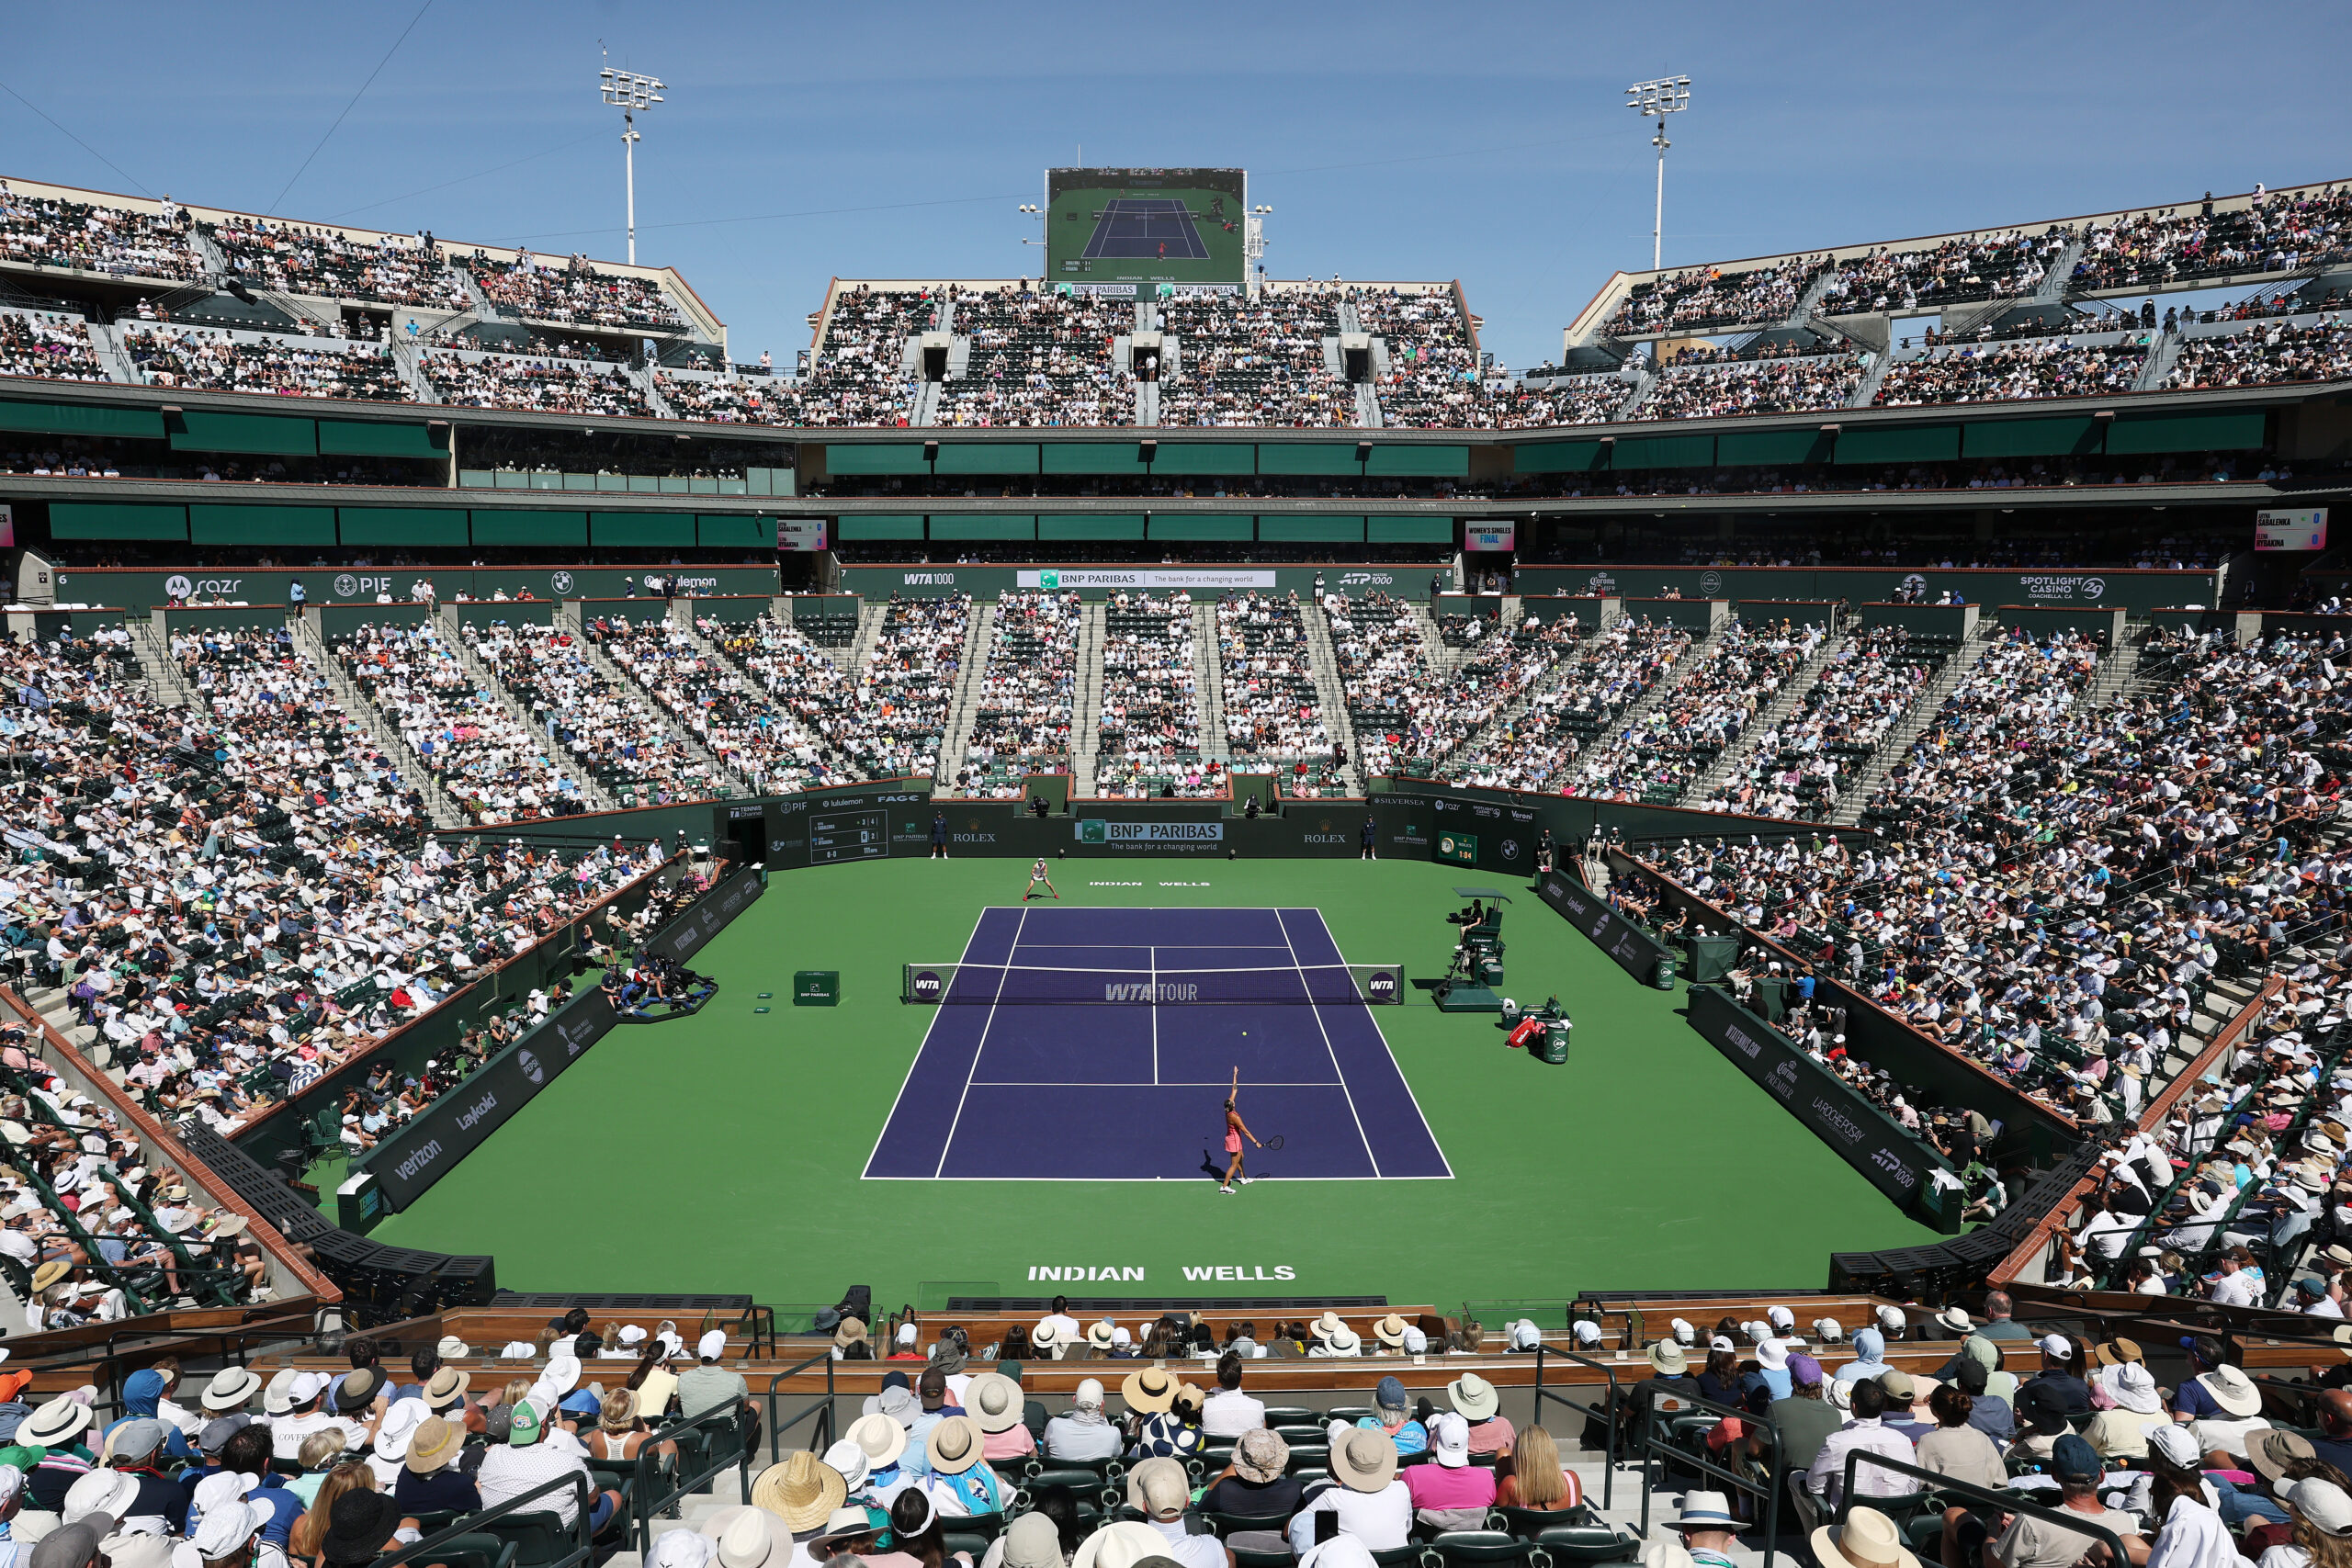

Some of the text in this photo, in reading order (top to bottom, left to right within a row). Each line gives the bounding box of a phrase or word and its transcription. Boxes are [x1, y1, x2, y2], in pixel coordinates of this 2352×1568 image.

[1074, 286, 1134, 294] BNP PARIBAS
[2257, 513, 2321, 527] SABALENKA 0
[1479, 534, 1499, 543] FINAL
[2256, 534, 2319, 547] RYBAKINA 0
[773, 570, 778, 578] 7
[1446, 569, 1452, 577] 8
[58, 574, 67, 585] 6
[904, 572, 955, 585] WTA 1000
[1061, 574, 1136, 583] BNP PARIBAS
[1185, 575, 1195, 585] for
[1203, 575, 1233, 585] changing
[1336, 572, 1372, 585] ATP
[1371, 576, 1393, 585] 1000
[1589, 576, 1615, 586] Corona
[2020, 576, 2084, 585] SPOTLIGHT
[2207, 577, 2212, 587] 1
[197, 579, 242, 593] razr
[359, 577, 391, 593] PIF
[2030, 584, 2072, 593] CASINO
[792, 801, 808, 812] PIF
[831, 798, 864, 807] lululemon
[1380, 797, 1425, 806] SILVERSEA
[1444, 802, 1461, 811] razr
[740, 805, 763, 813] TENNIS
[1511, 809, 1532, 820] Veroni
[1110, 824, 1217, 839] BNP PARIBAS
[953, 833, 996, 842] ROLEX
[1304, 834, 1346, 843] ROLEX
[1144, 842, 1156, 852] for
[1163, 842, 1195, 852] changing
[1459, 850, 1472, 860] 1:04
[916, 979, 939, 989] WTA
[1370, 979, 1394, 990] WTA
[1105, 983, 1198, 1001] WTA TOUR
[522, 1059, 539, 1075] PEPSI
[1776, 1061, 1798, 1083] Corona
[1765, 1071, 1794, 1100] PREMIER
[456, 1091, 497, 1131] Laykold
[394, 1139, 443, 1181] verizon
[1871, 1147, 1901, 1172] ATP
[1894, 1168, 1915, 1188] 1000
[1027, 1265, 1296, 1280] INDIAN WELLS
